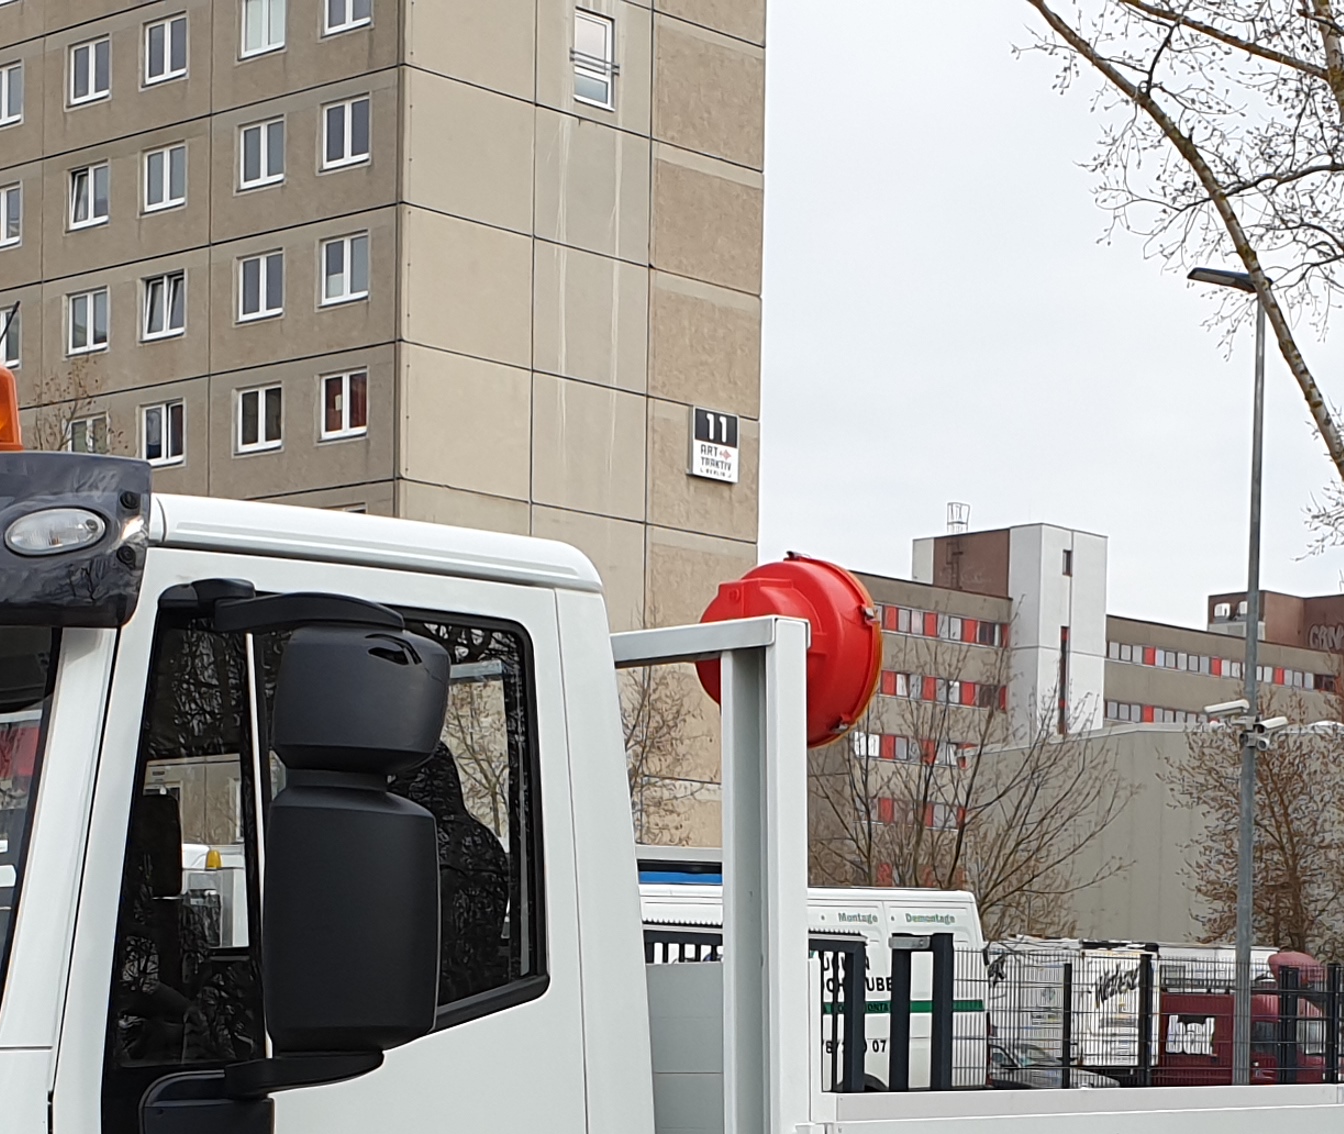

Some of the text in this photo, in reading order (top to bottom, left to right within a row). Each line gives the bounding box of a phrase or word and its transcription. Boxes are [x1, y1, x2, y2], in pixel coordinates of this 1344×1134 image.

[706, 413, 727, 443] 11
[700, 444, 718, 457] ART
[700, 456, 732, 472] TRAKTIV
[838, 912, 955, 924] Montage Demontage
